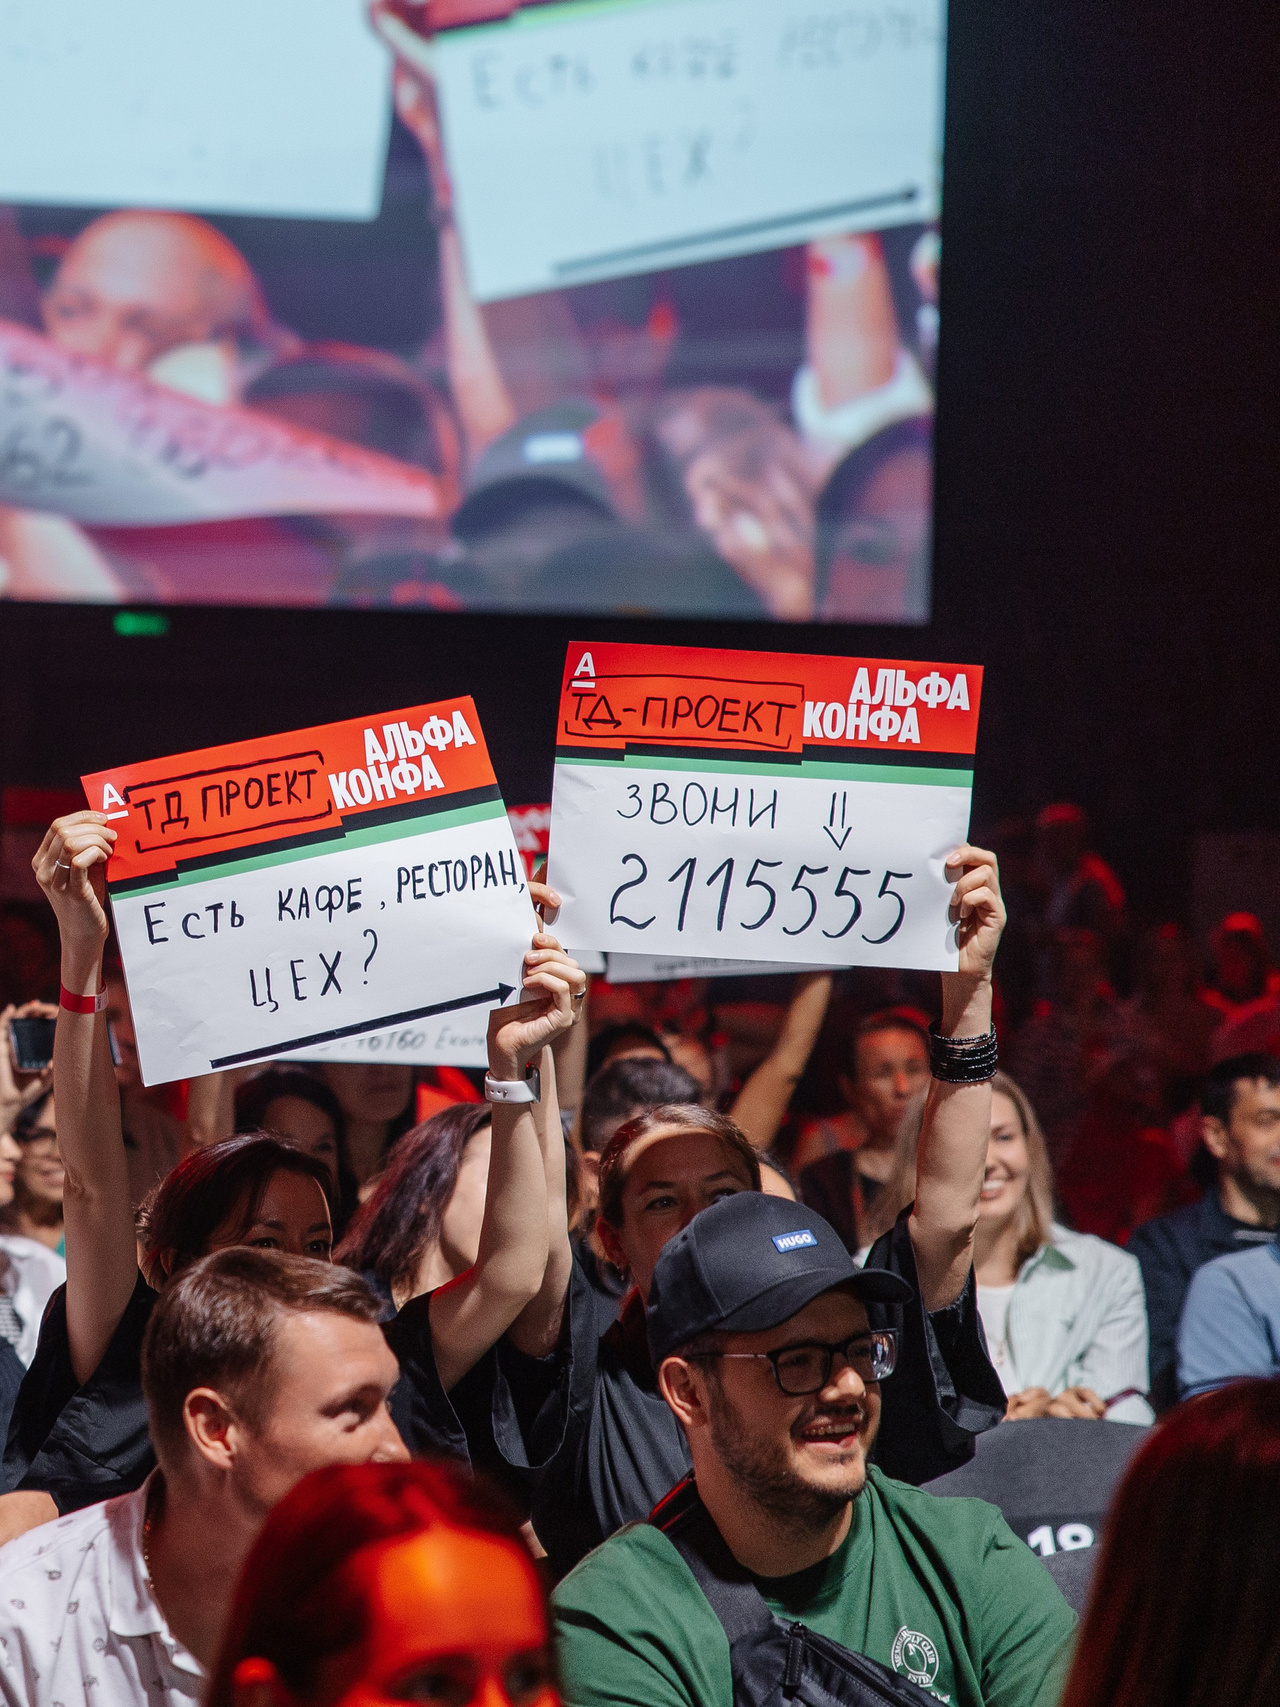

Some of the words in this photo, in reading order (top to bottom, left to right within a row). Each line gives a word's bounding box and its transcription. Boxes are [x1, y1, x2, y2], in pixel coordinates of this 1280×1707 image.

[849, 667, 970, 711] АЛЬФА
[363, 710, 476, 767] АЛЬФА
[803, 700, 920, 743] КОНФА
[133, 790, 190, 834] ТД
[202, 768, 318, 822] ПРОЕКТ
[328, 754, 445, 809] КОНФА
[609, 853, 913, 945] 2115555
[777, 1233, 812, 1249] HUGO
